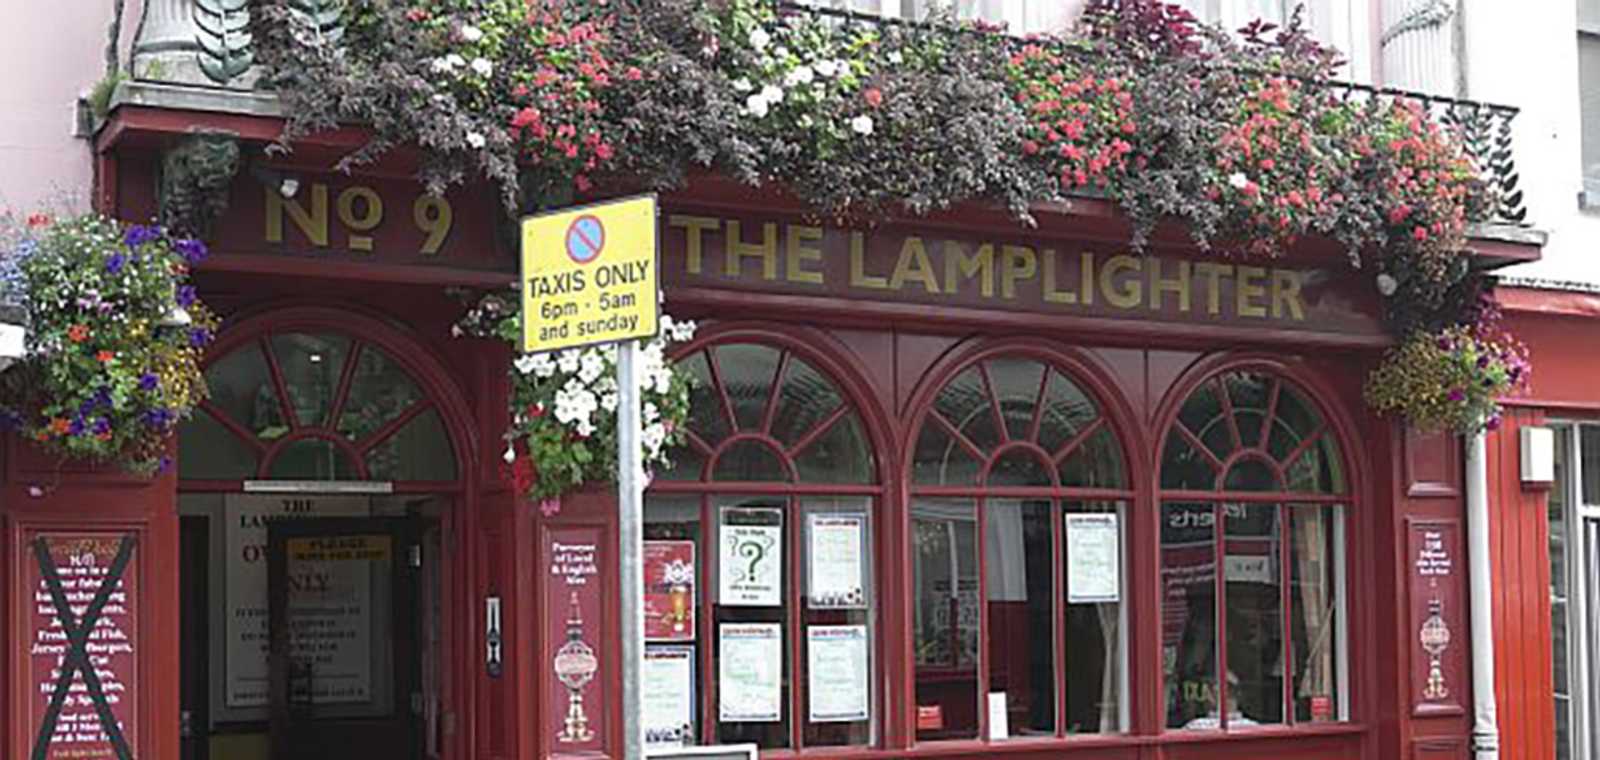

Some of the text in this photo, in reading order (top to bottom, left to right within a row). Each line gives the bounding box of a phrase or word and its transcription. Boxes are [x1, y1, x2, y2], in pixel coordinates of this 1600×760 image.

[414, 194, 452, 254] 9
[528, 260, 649, 299] TAXIS ONLY
[669, 214, 1305, 322] THE LAMPLIGHTER
[541, 301, 578, 321] 6pm
[599, 292, 636, 311] 5am
[539, 314, 639, 342] and sunday
